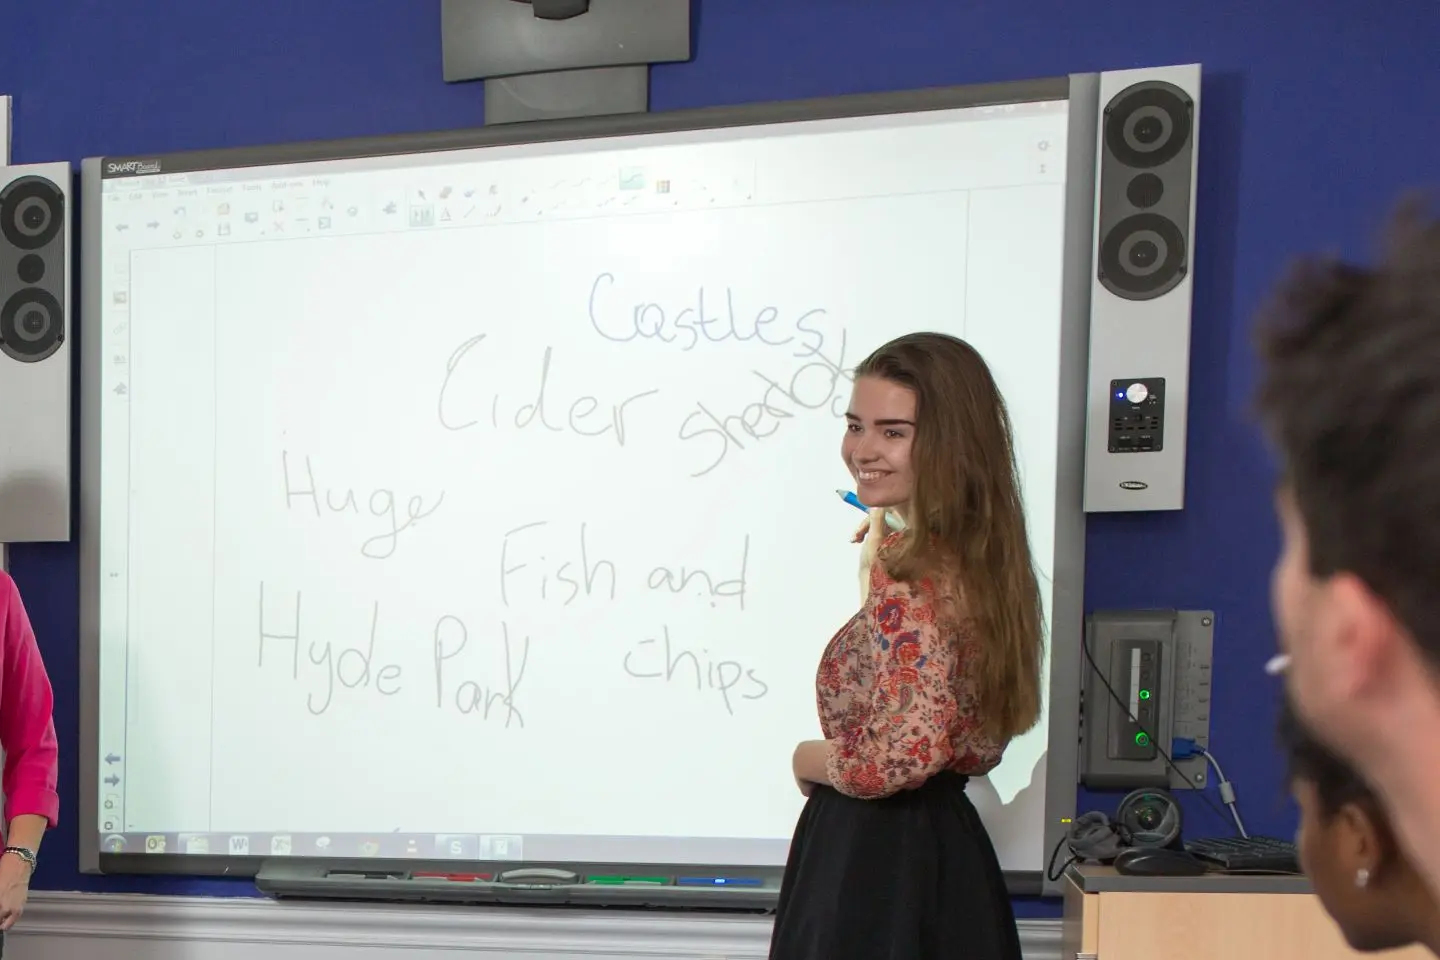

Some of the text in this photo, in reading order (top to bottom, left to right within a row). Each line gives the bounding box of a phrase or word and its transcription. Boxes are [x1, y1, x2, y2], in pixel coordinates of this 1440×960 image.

[108, 161, 139, 173] SMART
[589, 272, 827, 357] Castles
[438, 333, 659, 447] Cider
[282, 450, 445, 559] Huge
[500, 521, 750, 611] Fish and
[258, 580, 530, 728] Hyde Park
